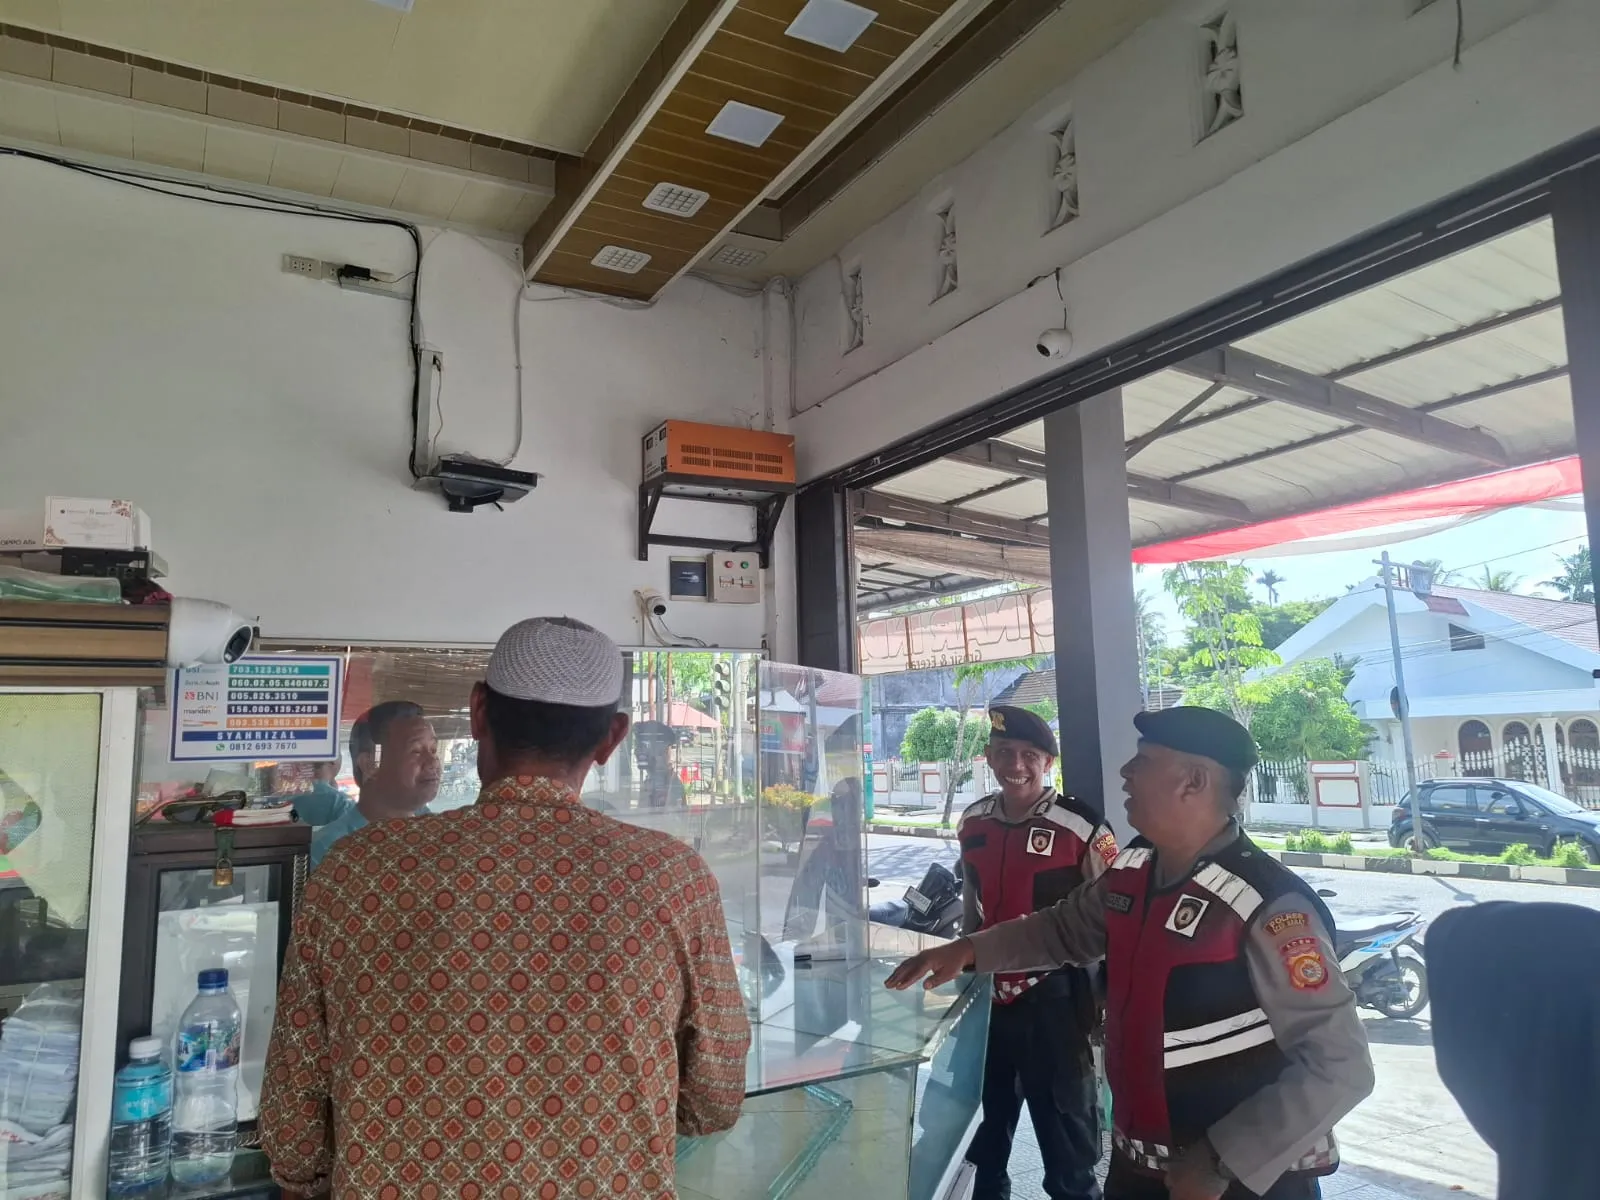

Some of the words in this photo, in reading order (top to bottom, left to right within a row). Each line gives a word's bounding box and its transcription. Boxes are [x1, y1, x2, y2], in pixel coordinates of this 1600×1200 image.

[196, 691, 219, 701] BNI
[216, 730, 296, 741] SYAHRIZAL
[229, 743, 253, 751] 0812
[255, 742, 273, 751] 693
[1269, 912, 1305, 929] POLRES
